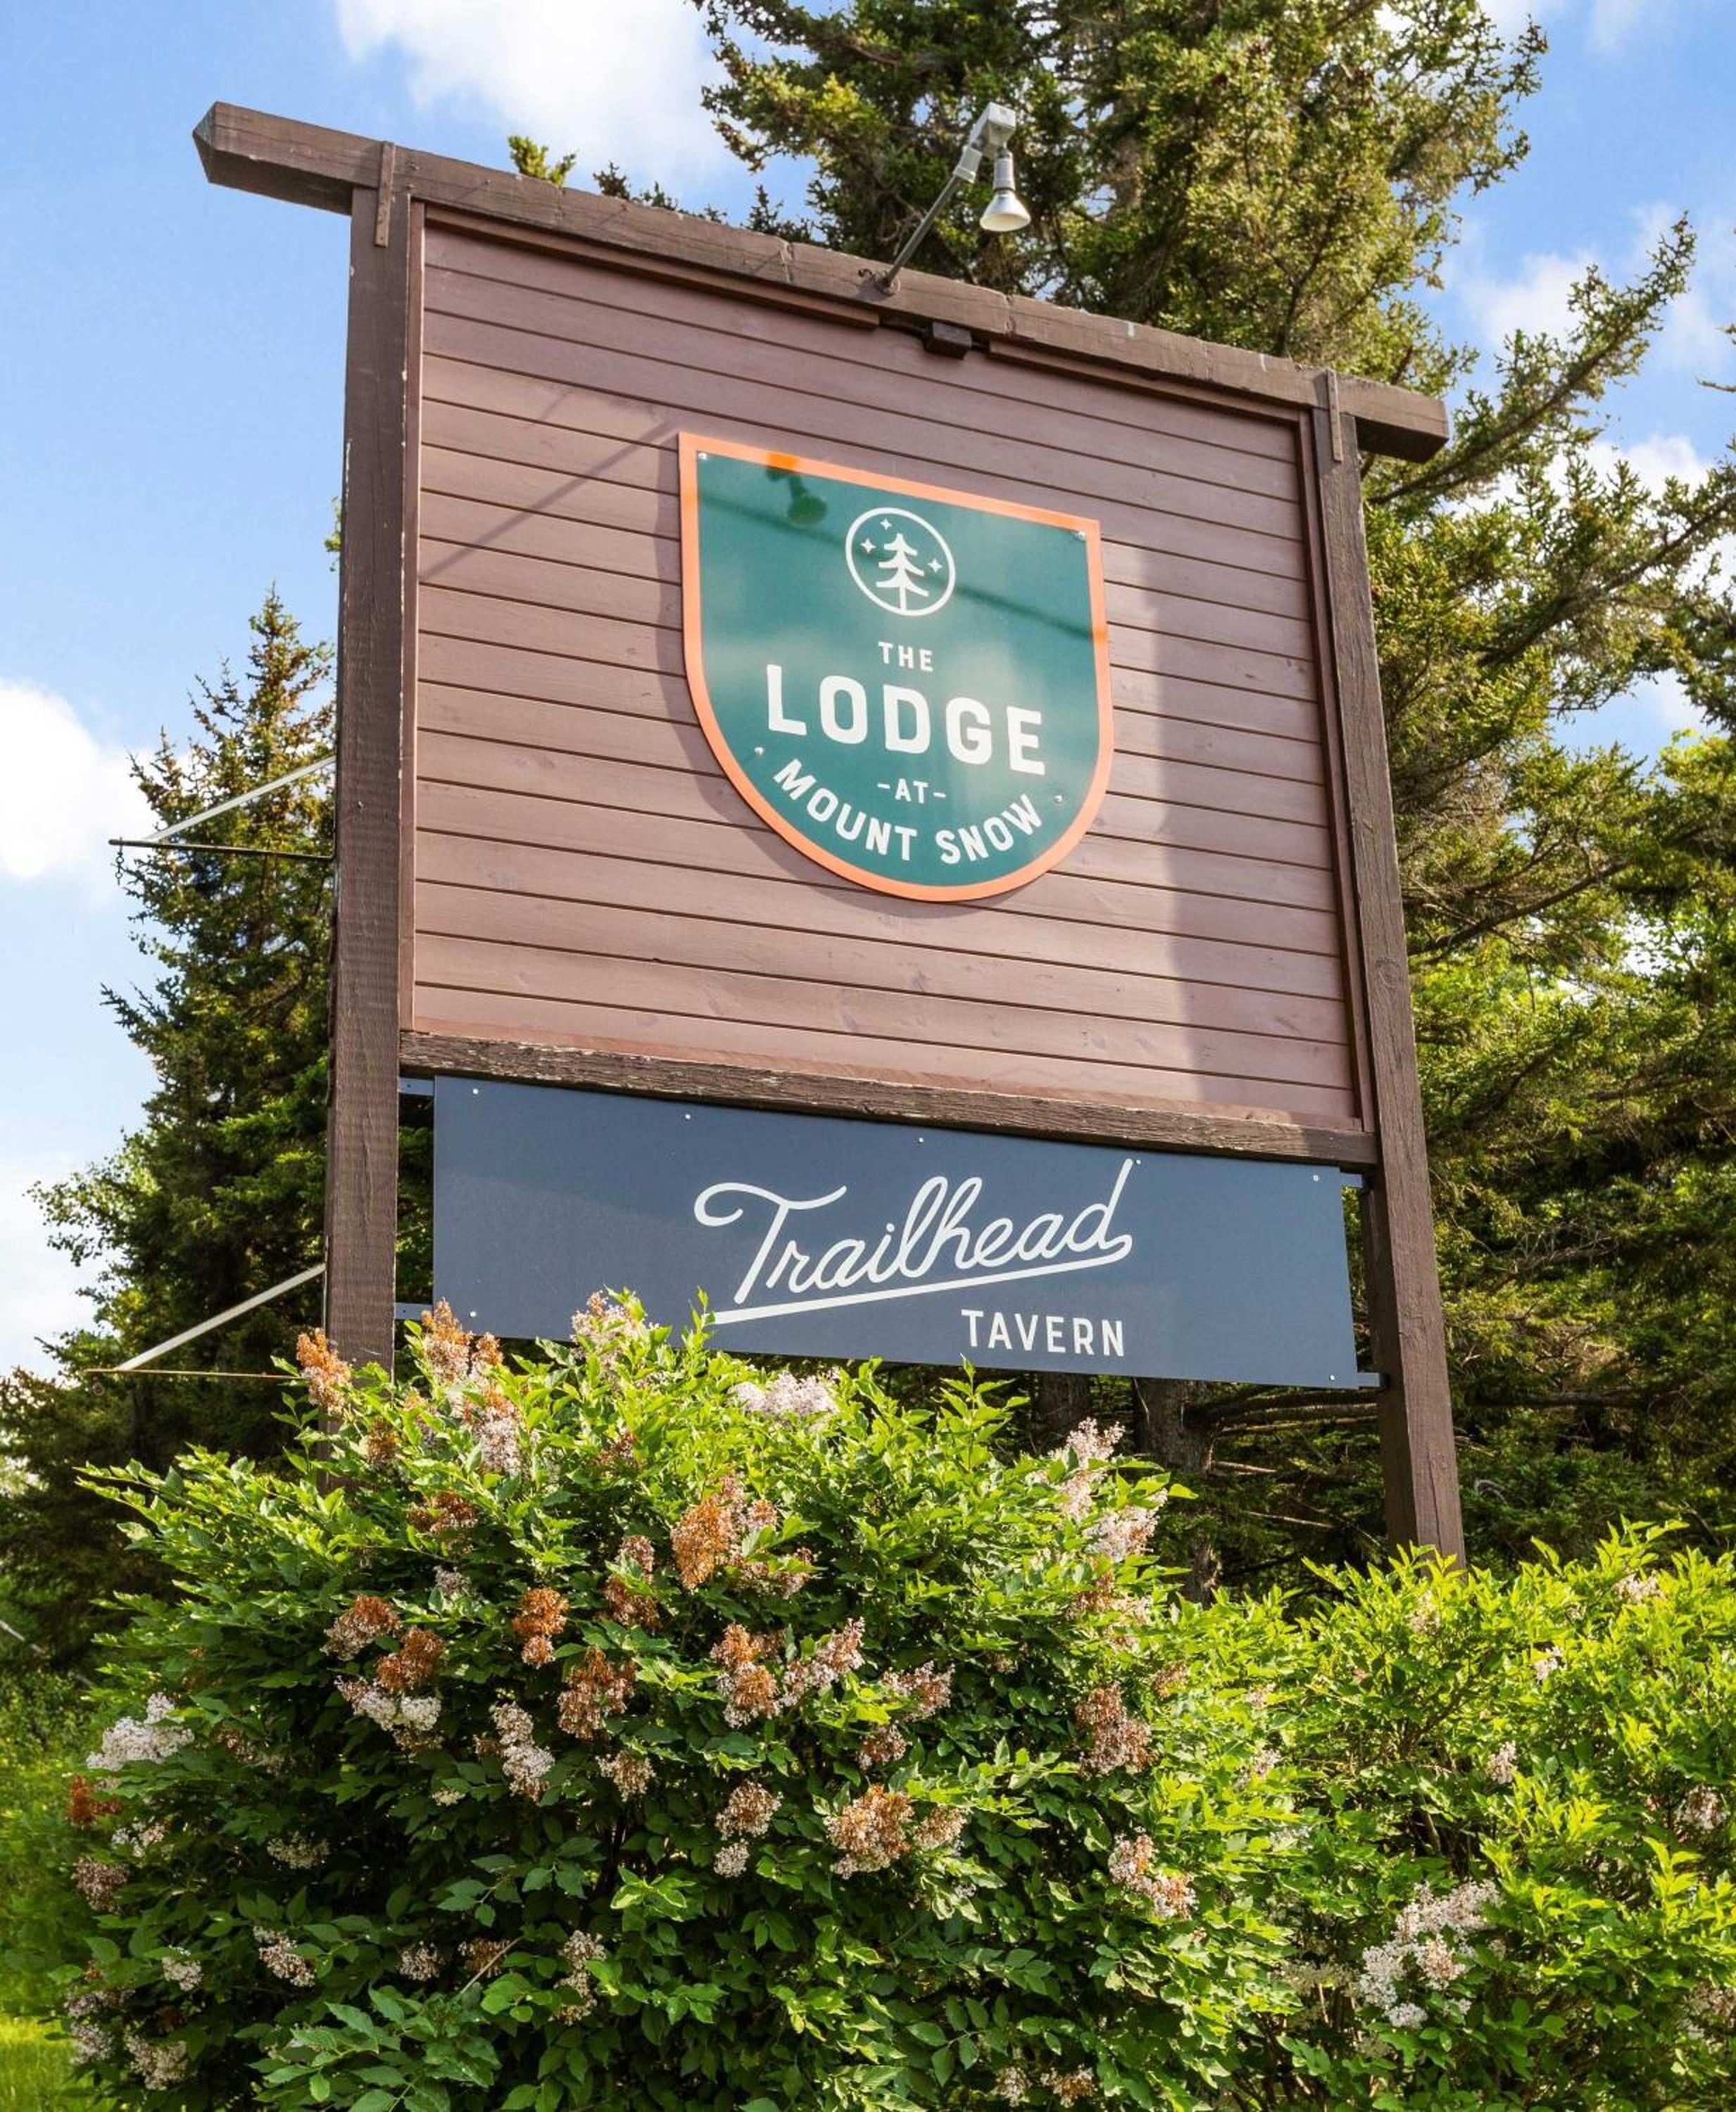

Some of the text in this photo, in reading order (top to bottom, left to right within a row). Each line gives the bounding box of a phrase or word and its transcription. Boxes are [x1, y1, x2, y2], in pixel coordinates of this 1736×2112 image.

[879, 641, 933, 671] THE
[767, 665, 1046, 777] LODGE
[772, 758, 1043, 865] MOUNT SNOW
[693, 1158, 1133, 1305] Trailhead
[960, 1309, 1125, 1357] TAVERN
